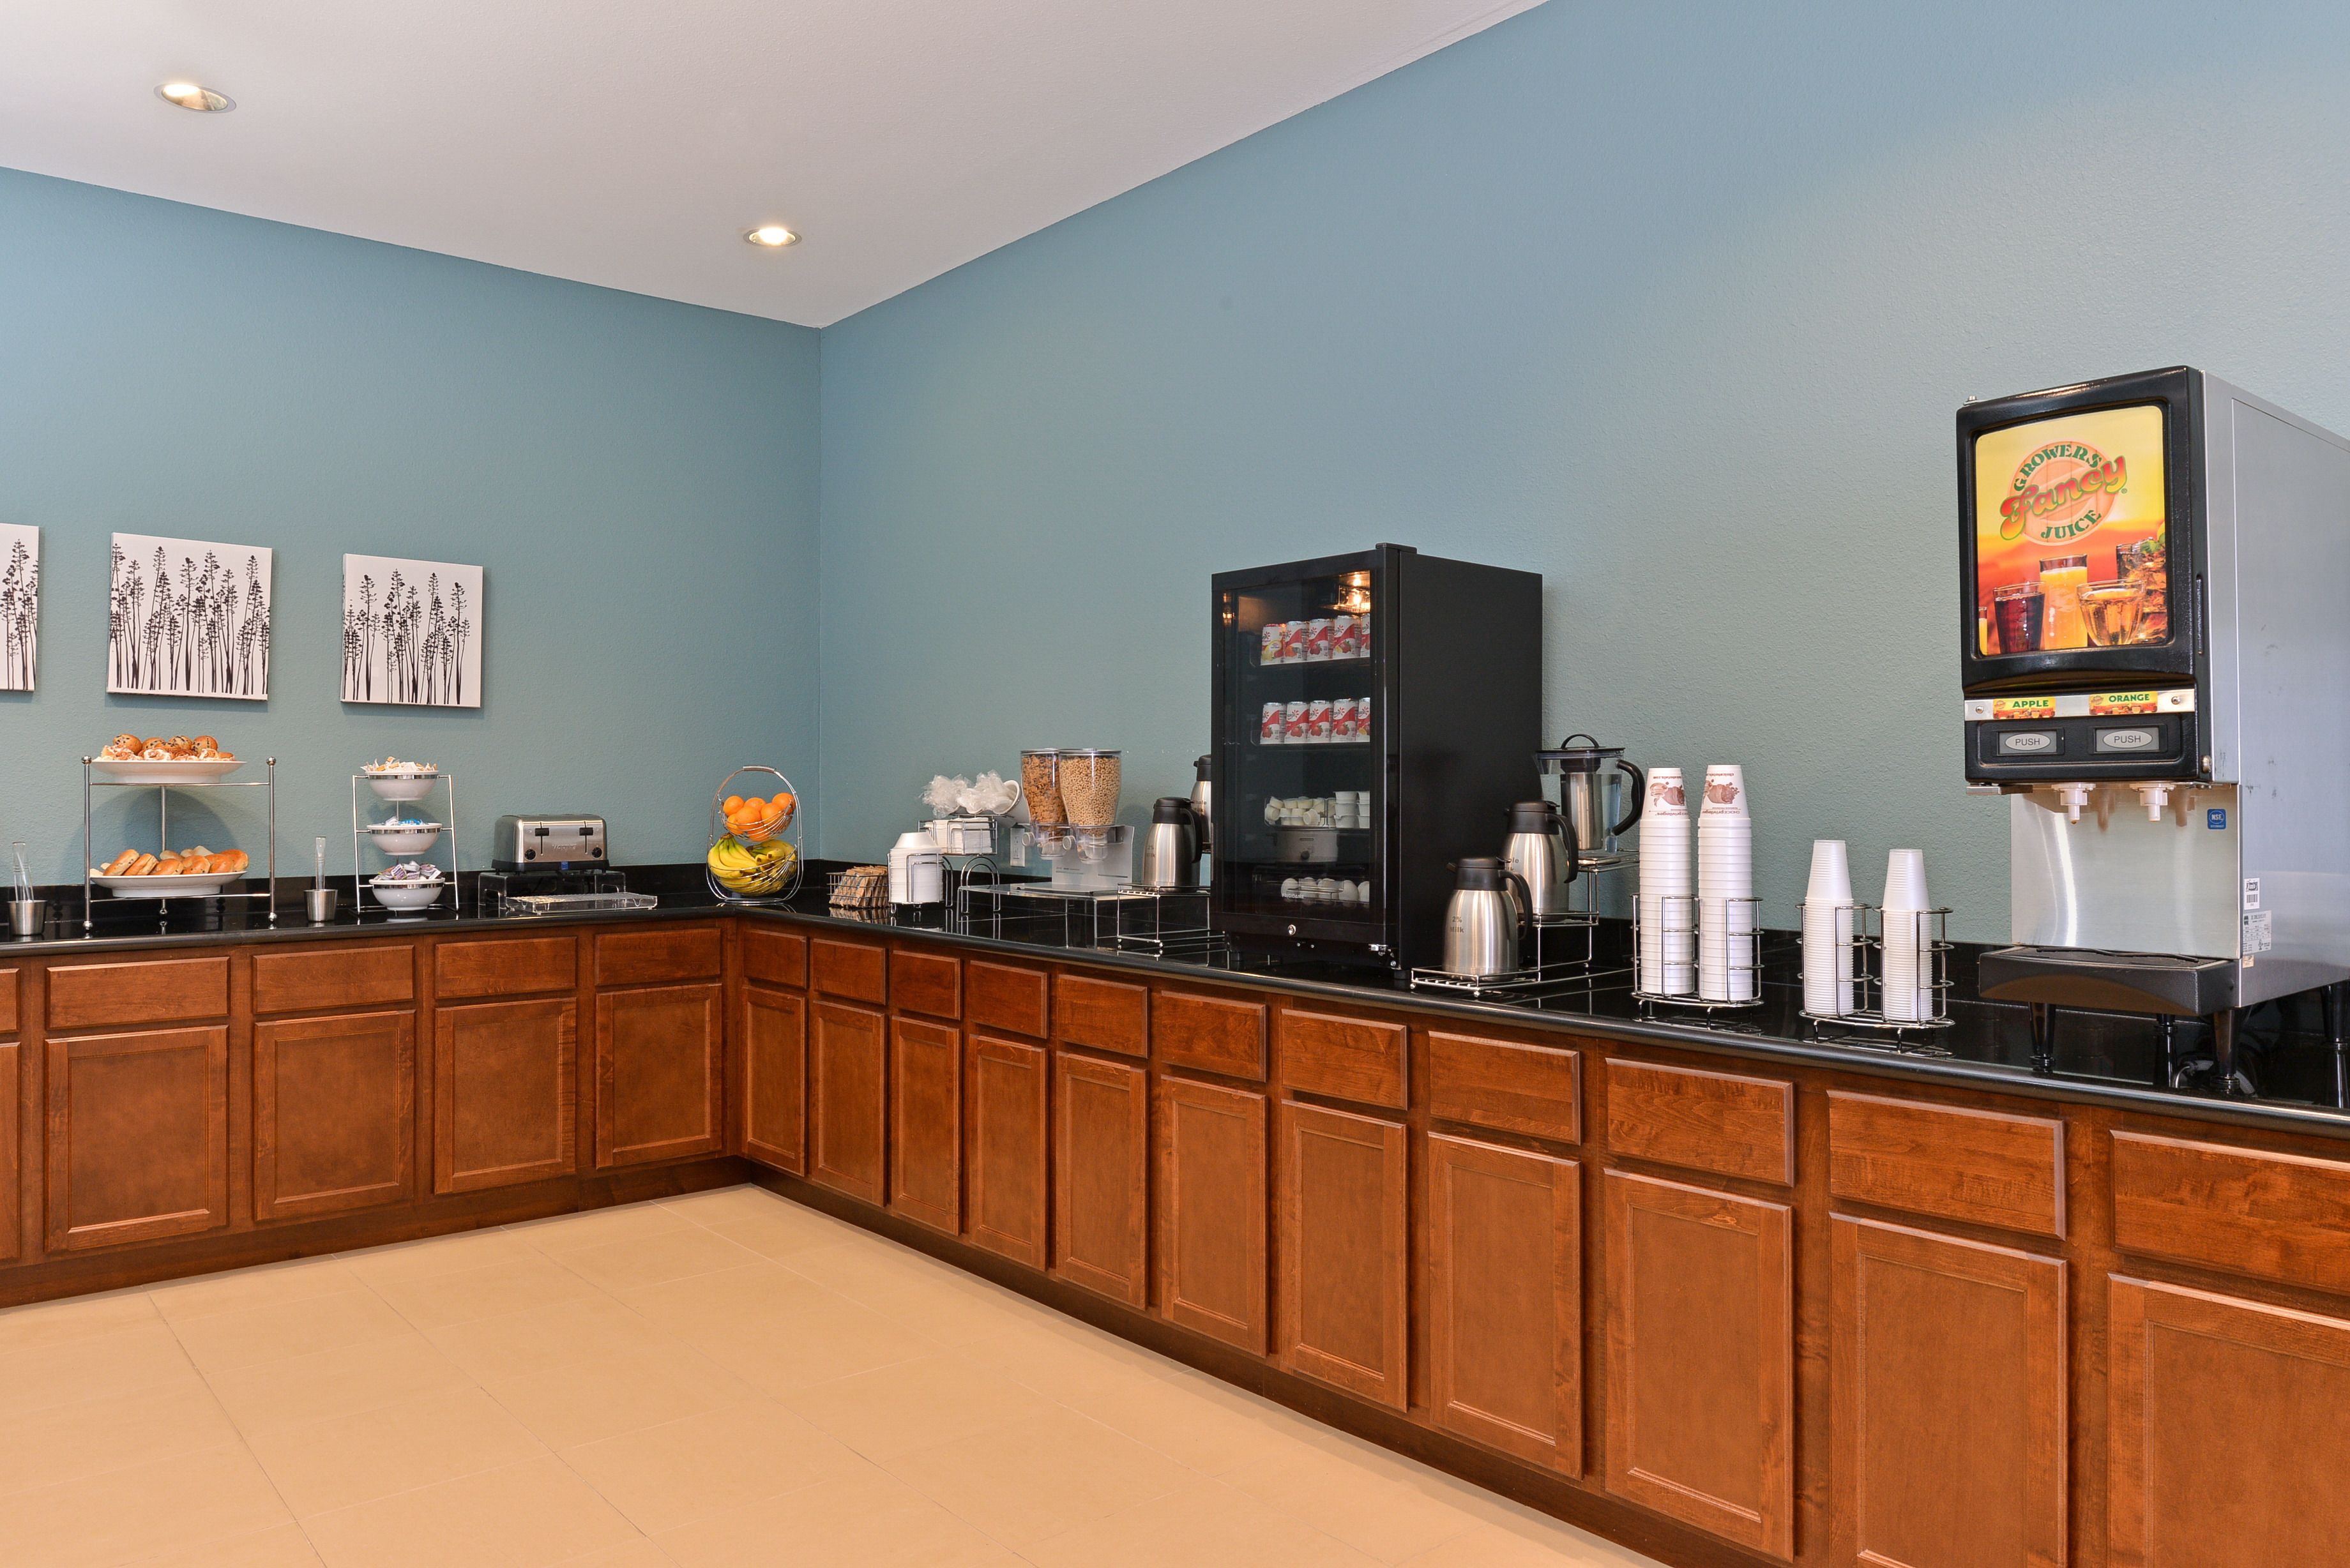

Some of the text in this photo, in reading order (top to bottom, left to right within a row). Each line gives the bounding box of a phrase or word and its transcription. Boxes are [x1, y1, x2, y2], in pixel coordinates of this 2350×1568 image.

[2013, 444, 2102, 492] GROWERS
[1999, 455, 2128, 541] Fancy
[2040, 509, 2102, 539] JUICE
[2109, 694, 2150, 702] ORANGE
[2012, 700, 2049, 708] APPLE
[2015, 738, 2040, 746] PUSH
[2114, 735, 2141, 743] PUSH
